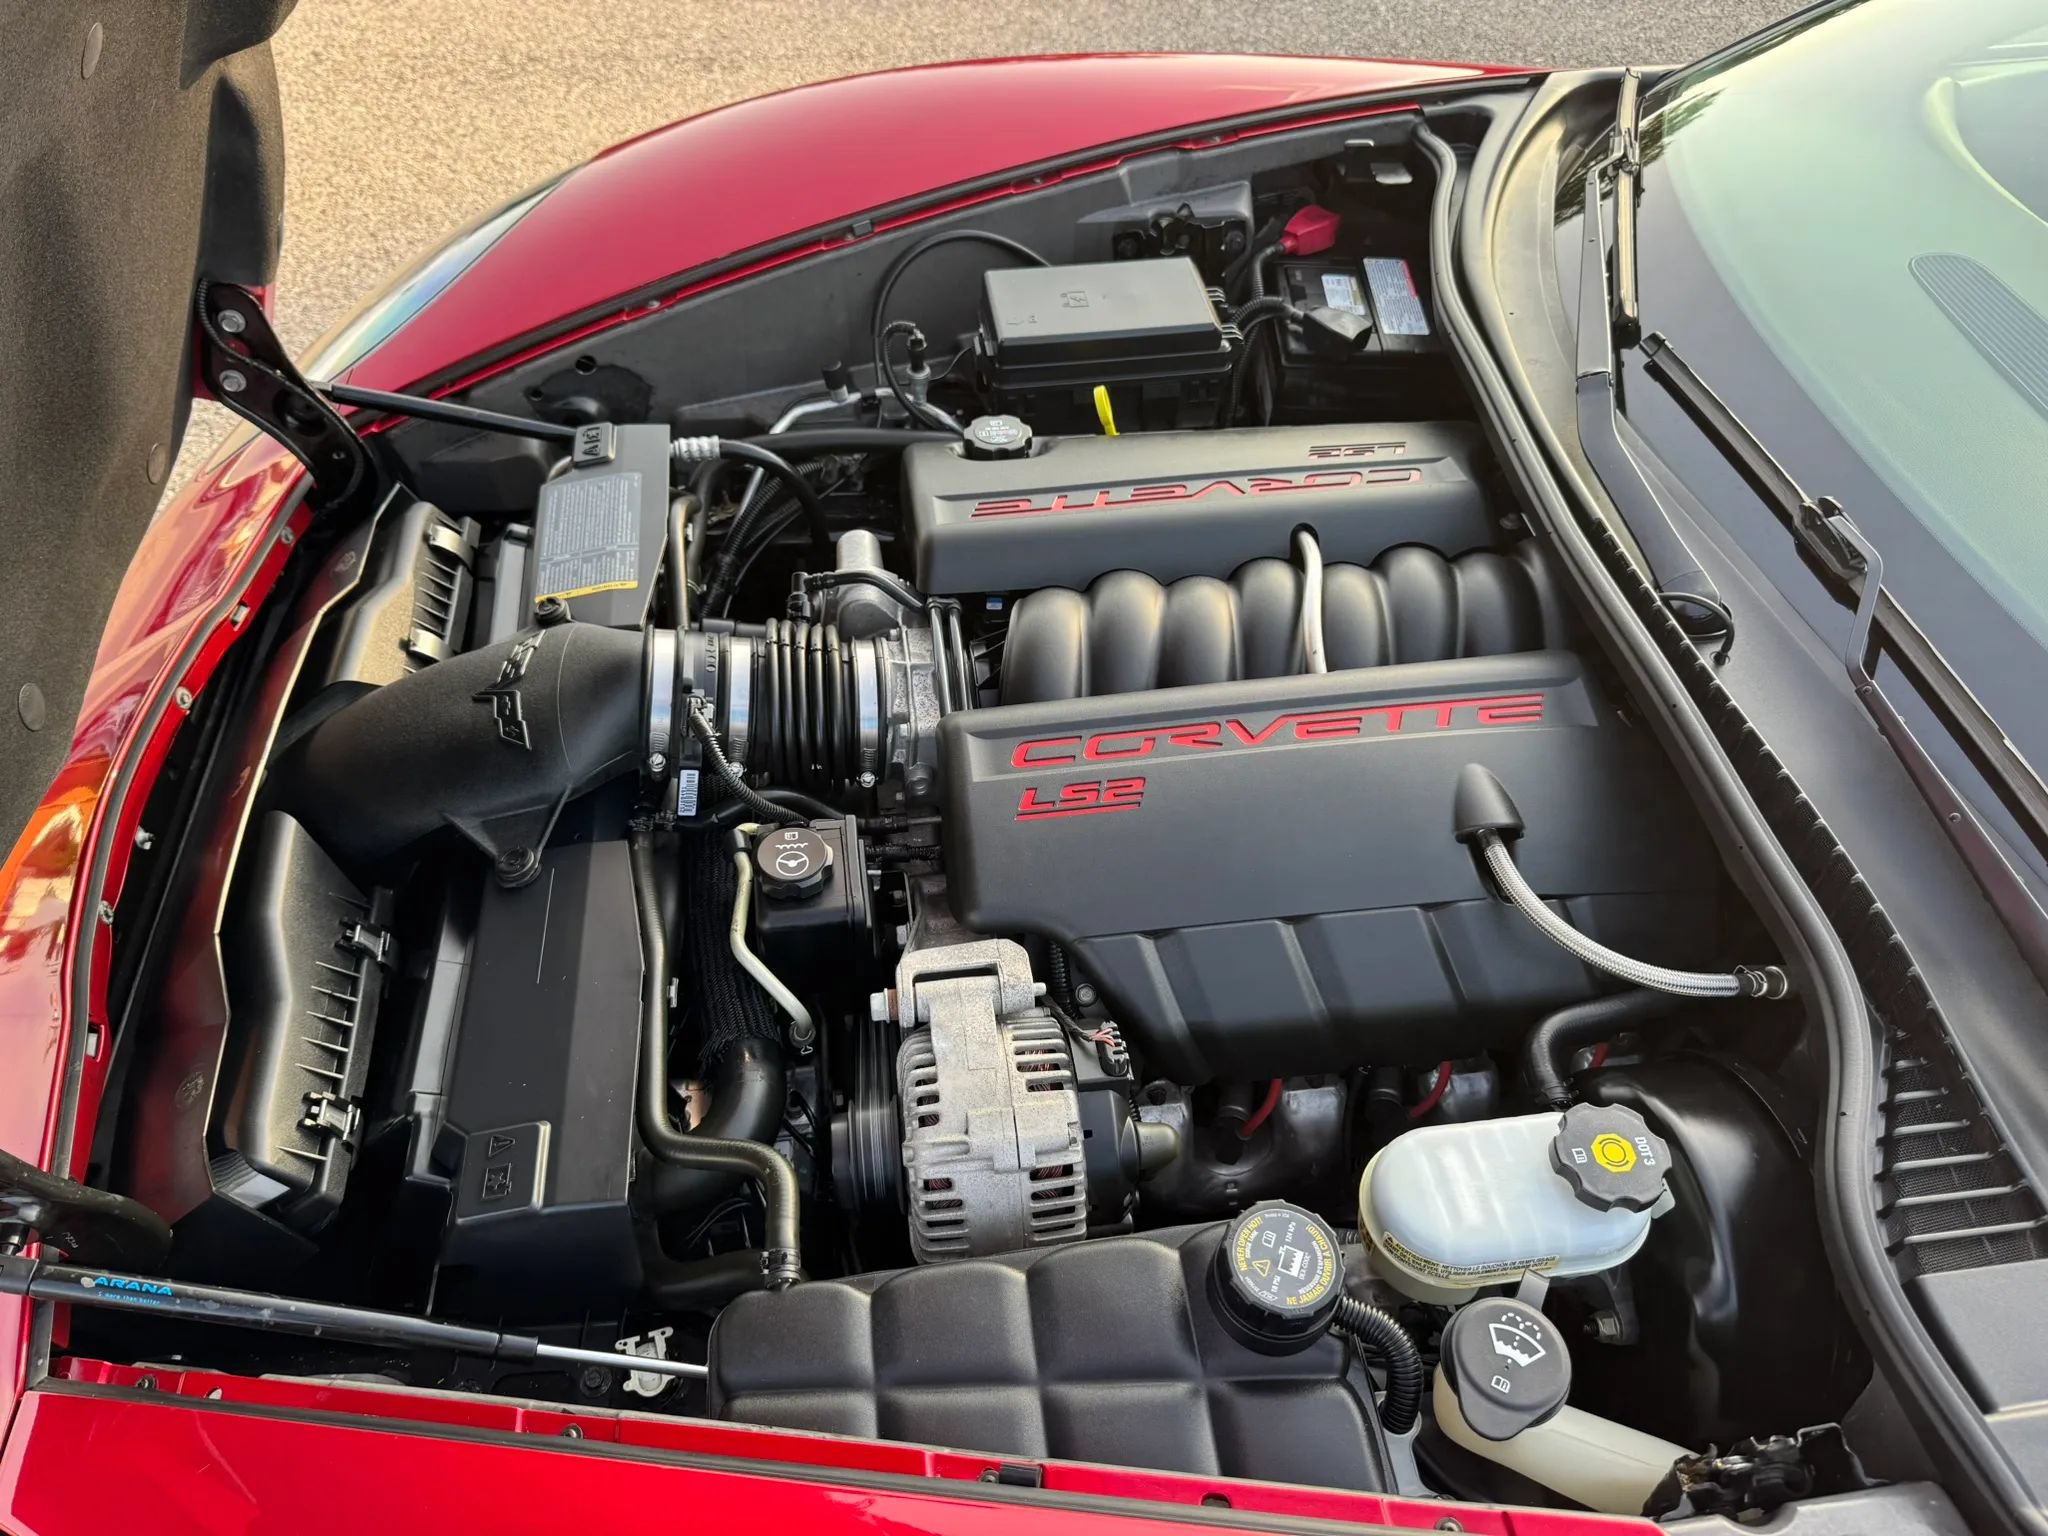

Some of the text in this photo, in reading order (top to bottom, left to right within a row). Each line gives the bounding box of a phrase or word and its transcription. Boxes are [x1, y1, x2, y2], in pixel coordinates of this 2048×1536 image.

[1308, 441, 1407, 460] LS2
[970, 467, 1422, 520] CORVETTE
[1010, 693, 1545, 769] CORVETTE
[1016, 776, 1146, 812] LS2
[1635, 1136, 1656, 1166] DOT 3
[1237, 1227, 1252, 1247] OPEN
[1285, 1231, 1293, 1243] 124
[1237, 1247, 1248, 1271] NEVER
[94, 1276, 173, 1296] ARANA
[1271, 1274, 1281, 1293] 18 PSI
[1286, 1296, 1298, 1305] NE
[1299, 1284, 1325, 1304] JAMAIS
[1320, 1258, 1333, 1286] OUVRIR
